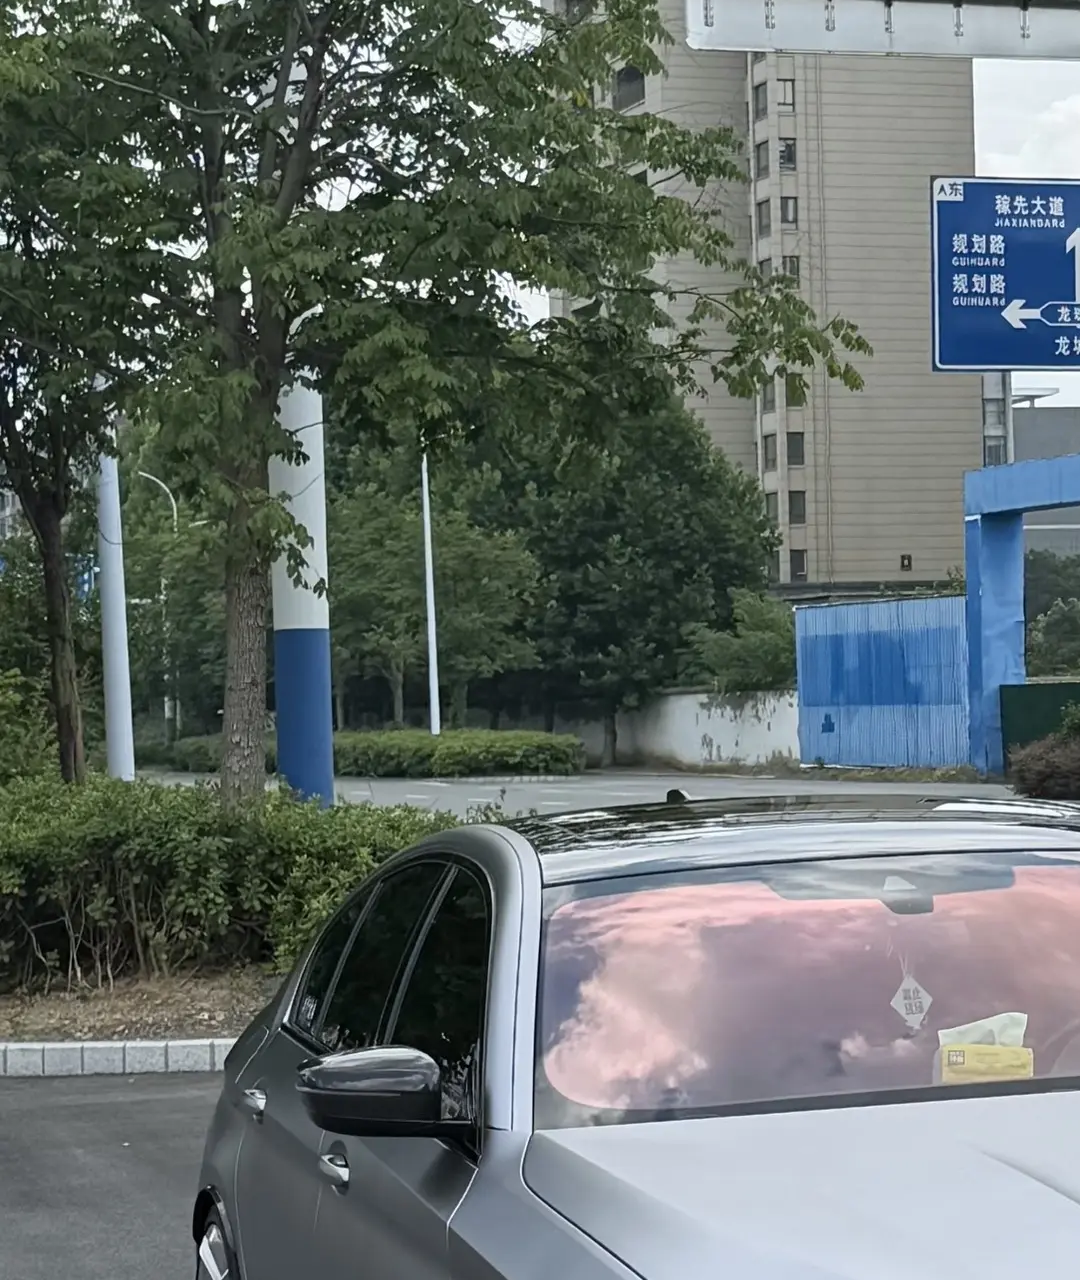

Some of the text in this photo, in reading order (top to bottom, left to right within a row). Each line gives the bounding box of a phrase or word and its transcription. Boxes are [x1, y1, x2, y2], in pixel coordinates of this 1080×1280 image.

[938, 183, 962, 196] A东
[953, 234, 1005, 254] 规划路
[953, 274, 1005, 294] 规划路
